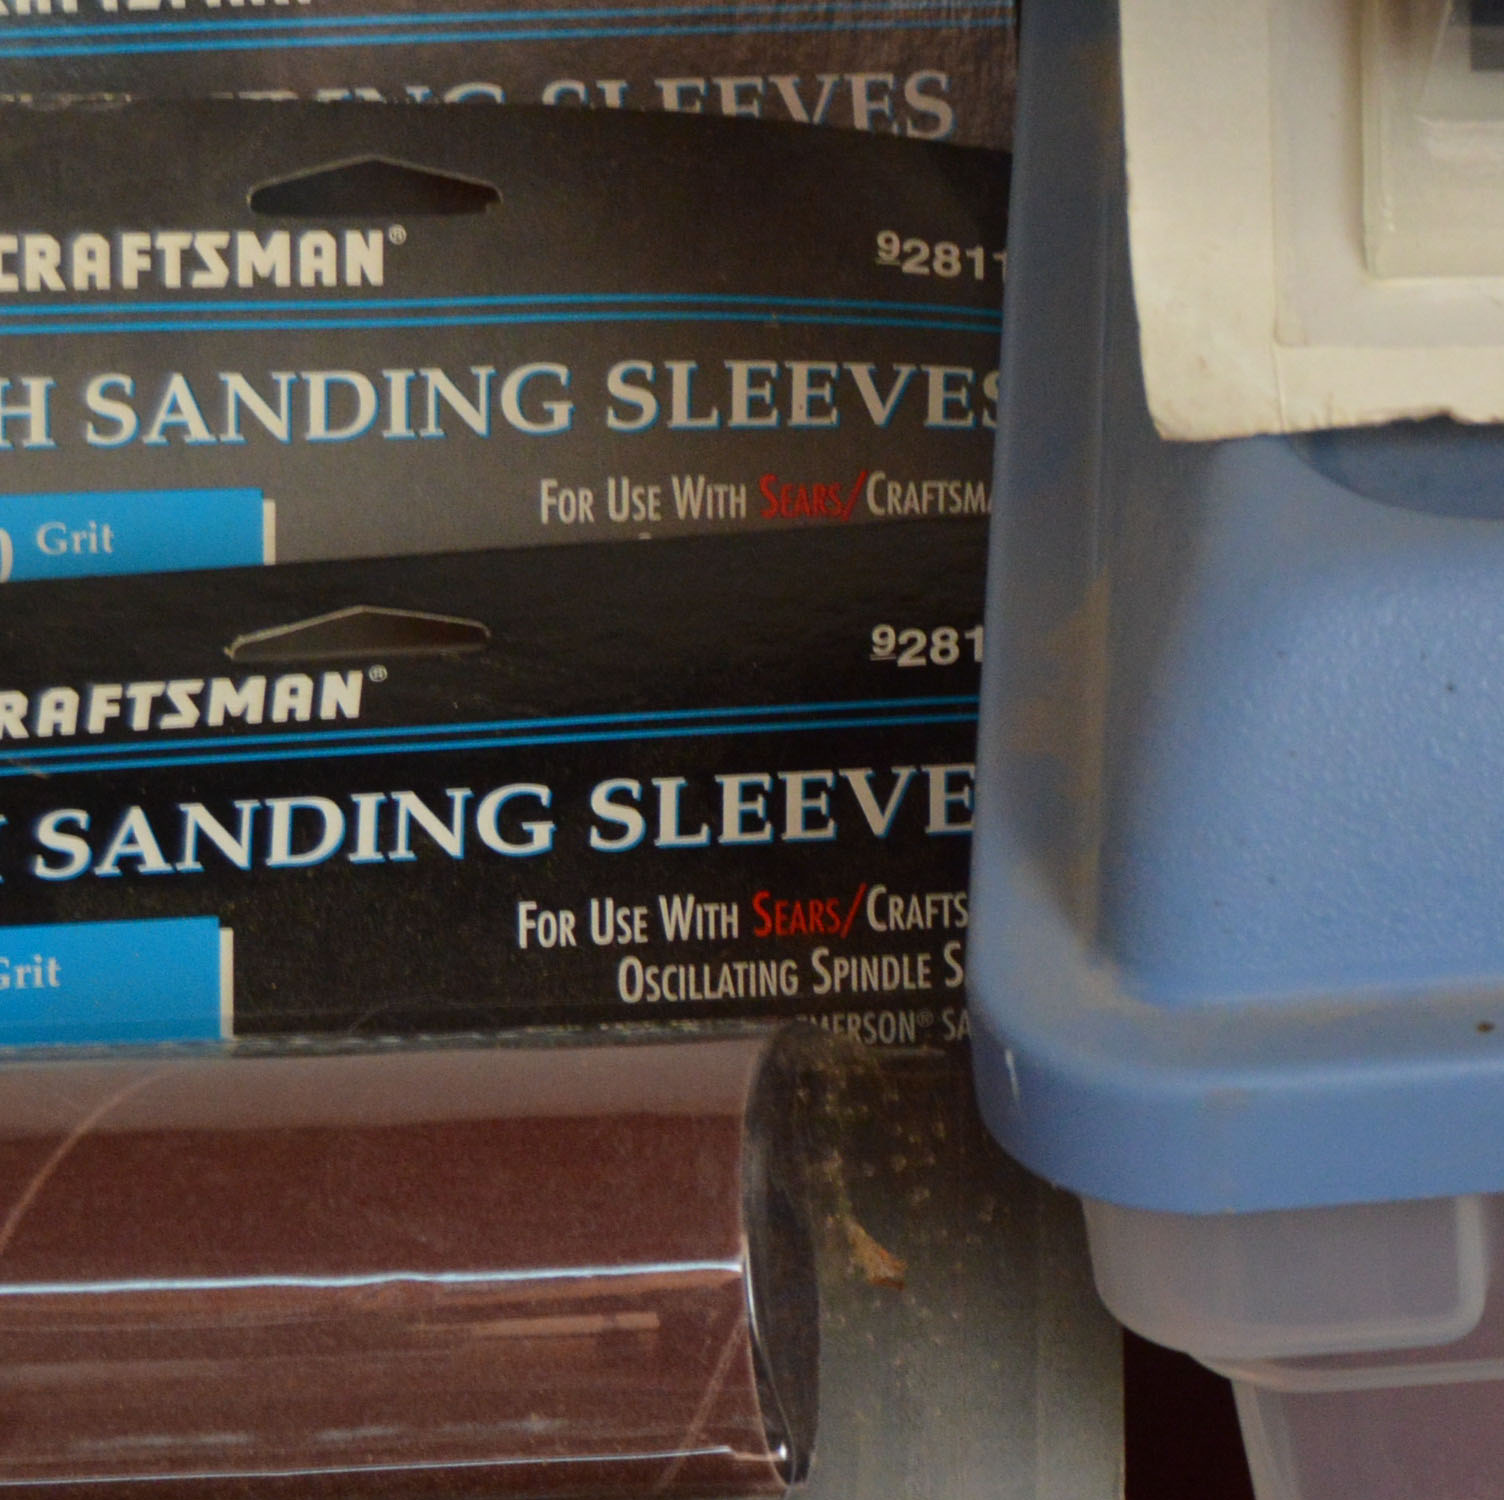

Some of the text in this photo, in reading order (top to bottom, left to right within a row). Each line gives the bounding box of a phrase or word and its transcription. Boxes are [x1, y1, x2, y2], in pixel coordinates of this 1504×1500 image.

[85, 362, 575, 450] SANDING
[540, 477, 595, 525] FOR
[607, 475, 662, 523] USE
[670, 474, 747, 521] WITH
[36, 520, 115, 556] Grit
[33, 781, 557, 882] SANDING
[517, 900, 577, 949] FOR
[589, 897, 649, 946] USE
[658, 893, 739, 942] WITH
[618, 955, 799, 1004] OSCILLATING
[810, 945, 932, 995] SPINDLE
